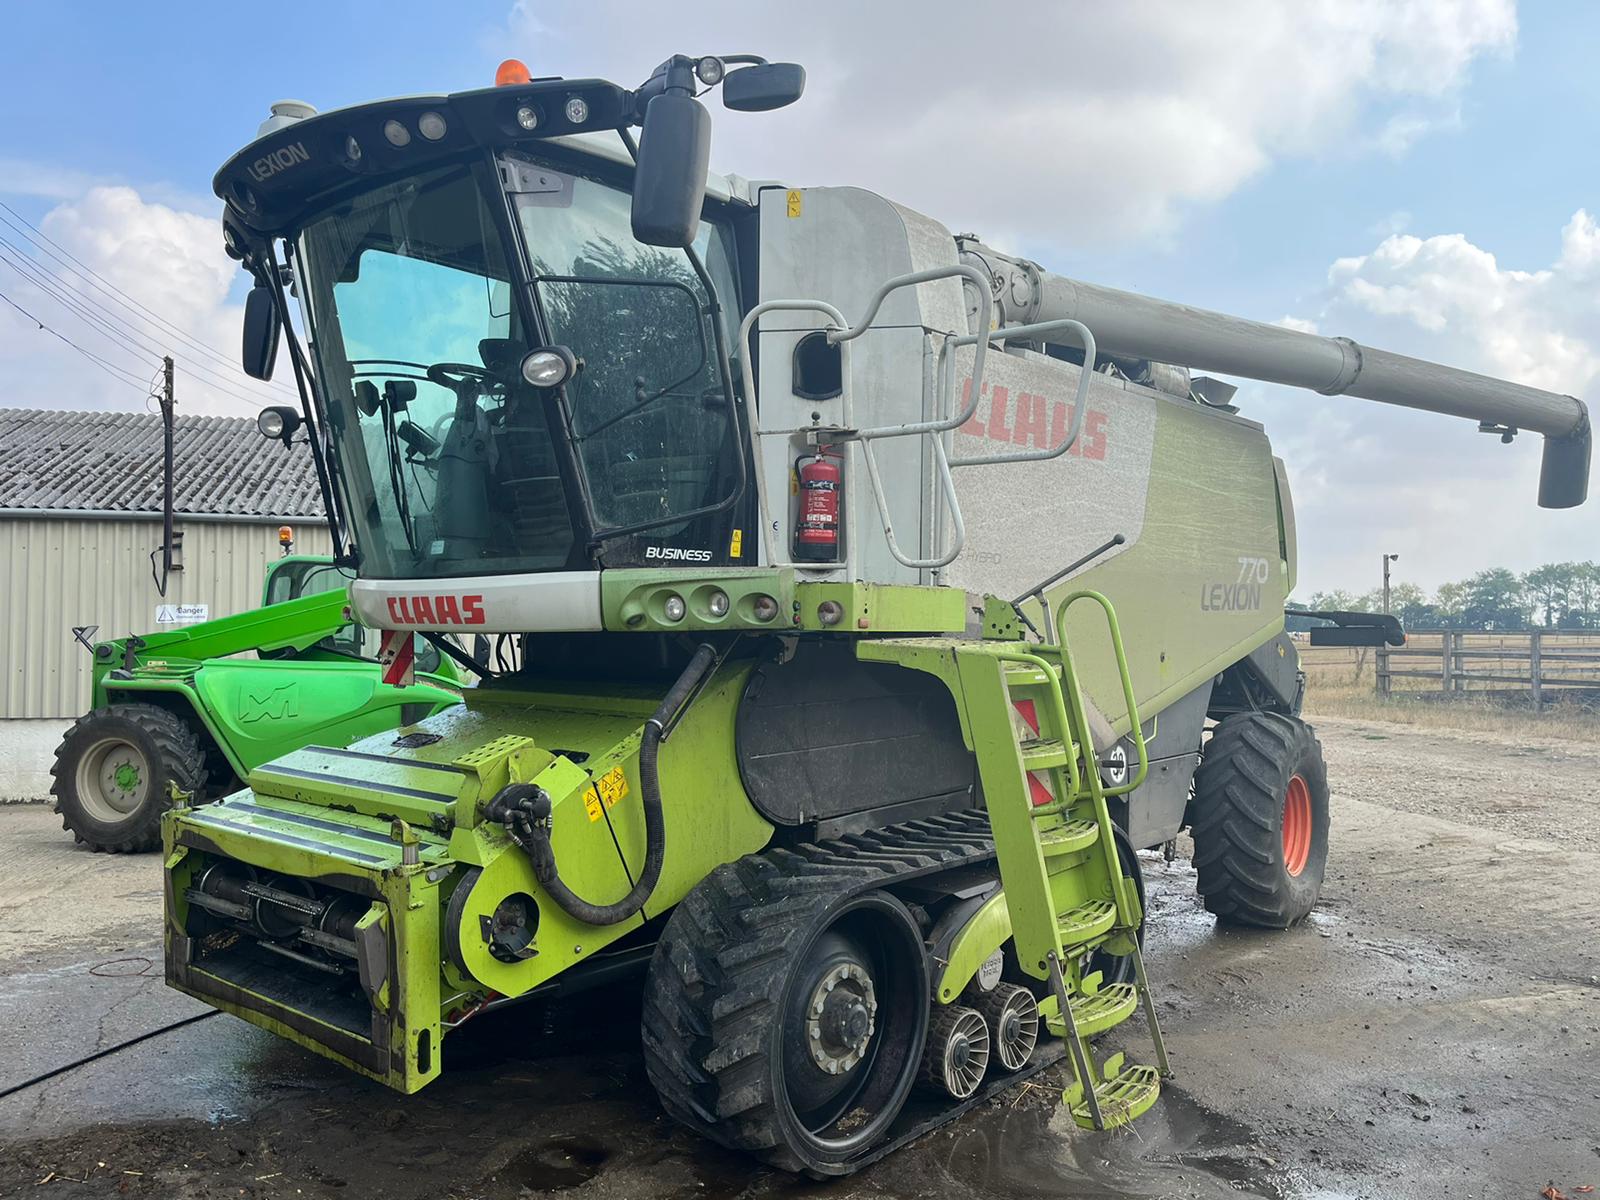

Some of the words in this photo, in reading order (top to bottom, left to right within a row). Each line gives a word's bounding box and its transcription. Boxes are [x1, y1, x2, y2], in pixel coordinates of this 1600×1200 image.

[246, 142, 310, 182] LEXION
[959, 376, 1109, 461] CLAAS
[645, 546, 712, 562] BUSINESS
[1237, 557, 1268, 584] 770
[386, 595, 486, 625] CLAAS
[1201, 583, 1261, 611] LEXION
